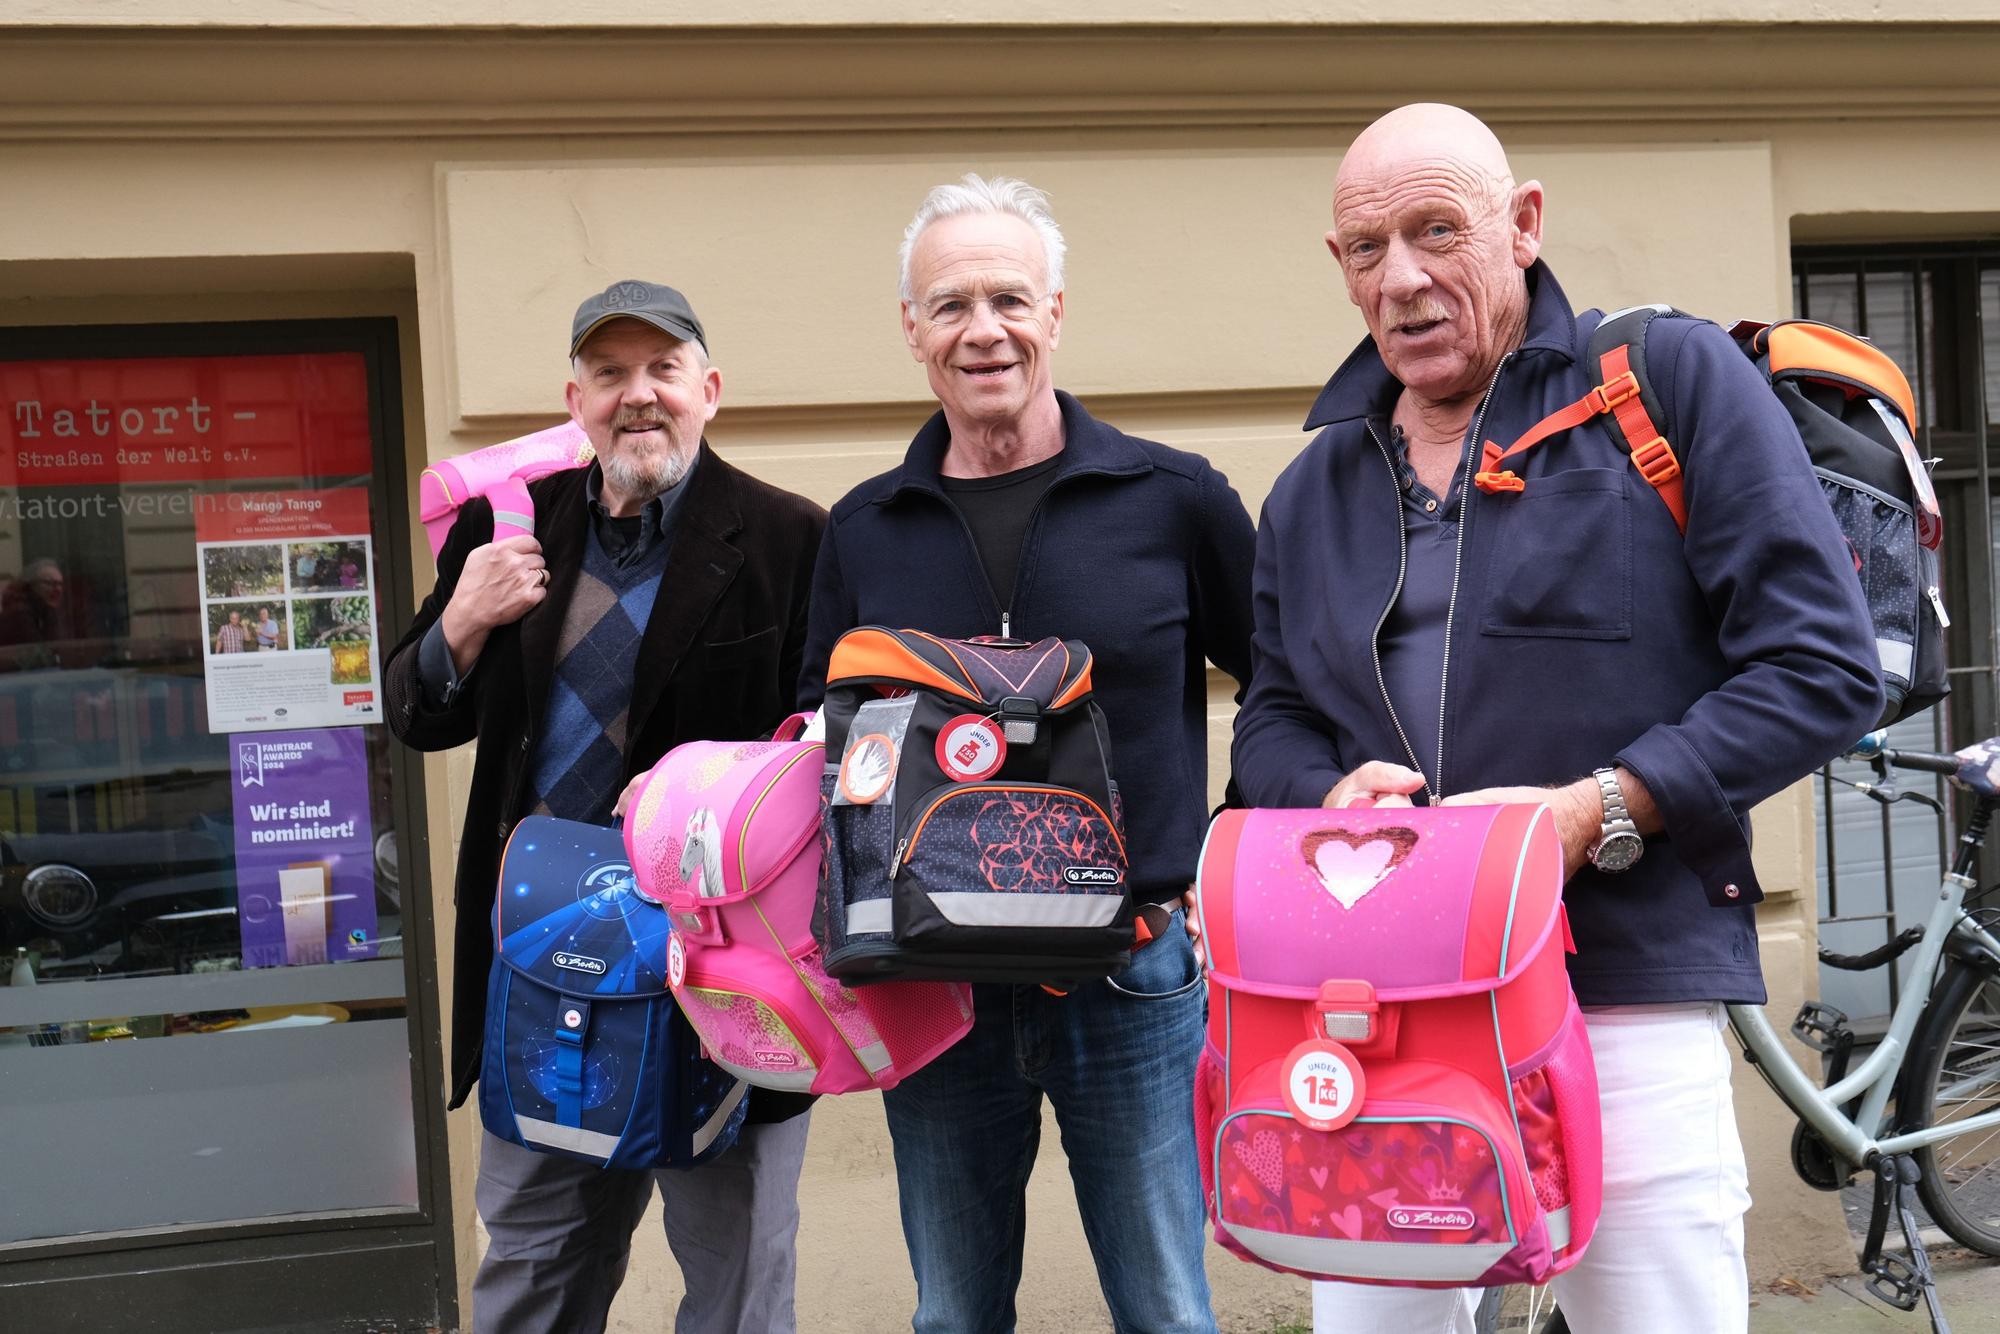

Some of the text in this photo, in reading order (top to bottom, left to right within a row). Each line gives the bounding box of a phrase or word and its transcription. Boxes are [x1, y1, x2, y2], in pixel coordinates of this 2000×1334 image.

[608, 283, 646, 305] BVB
[15, 397, 211, 438] Tatort
[17, 447, 258, 468] Straßen der Welt e.V.
[0, 488, 282, 520] .tatort-verein.org
[243, 499, 322, 513] Mango Tango
[262, 742, 313, 752] FAIRTRADE
[263, 752, 303, 761] AWARDS
[961, 745, 977, 759] 750
[249, 799, 332, 822] Wir sind
[251, 820, 356, 844] nominiert!
[1308, 1061, 1337, 1074] UNDER
[1303, 1075, 1338, 1104] 1 KG
